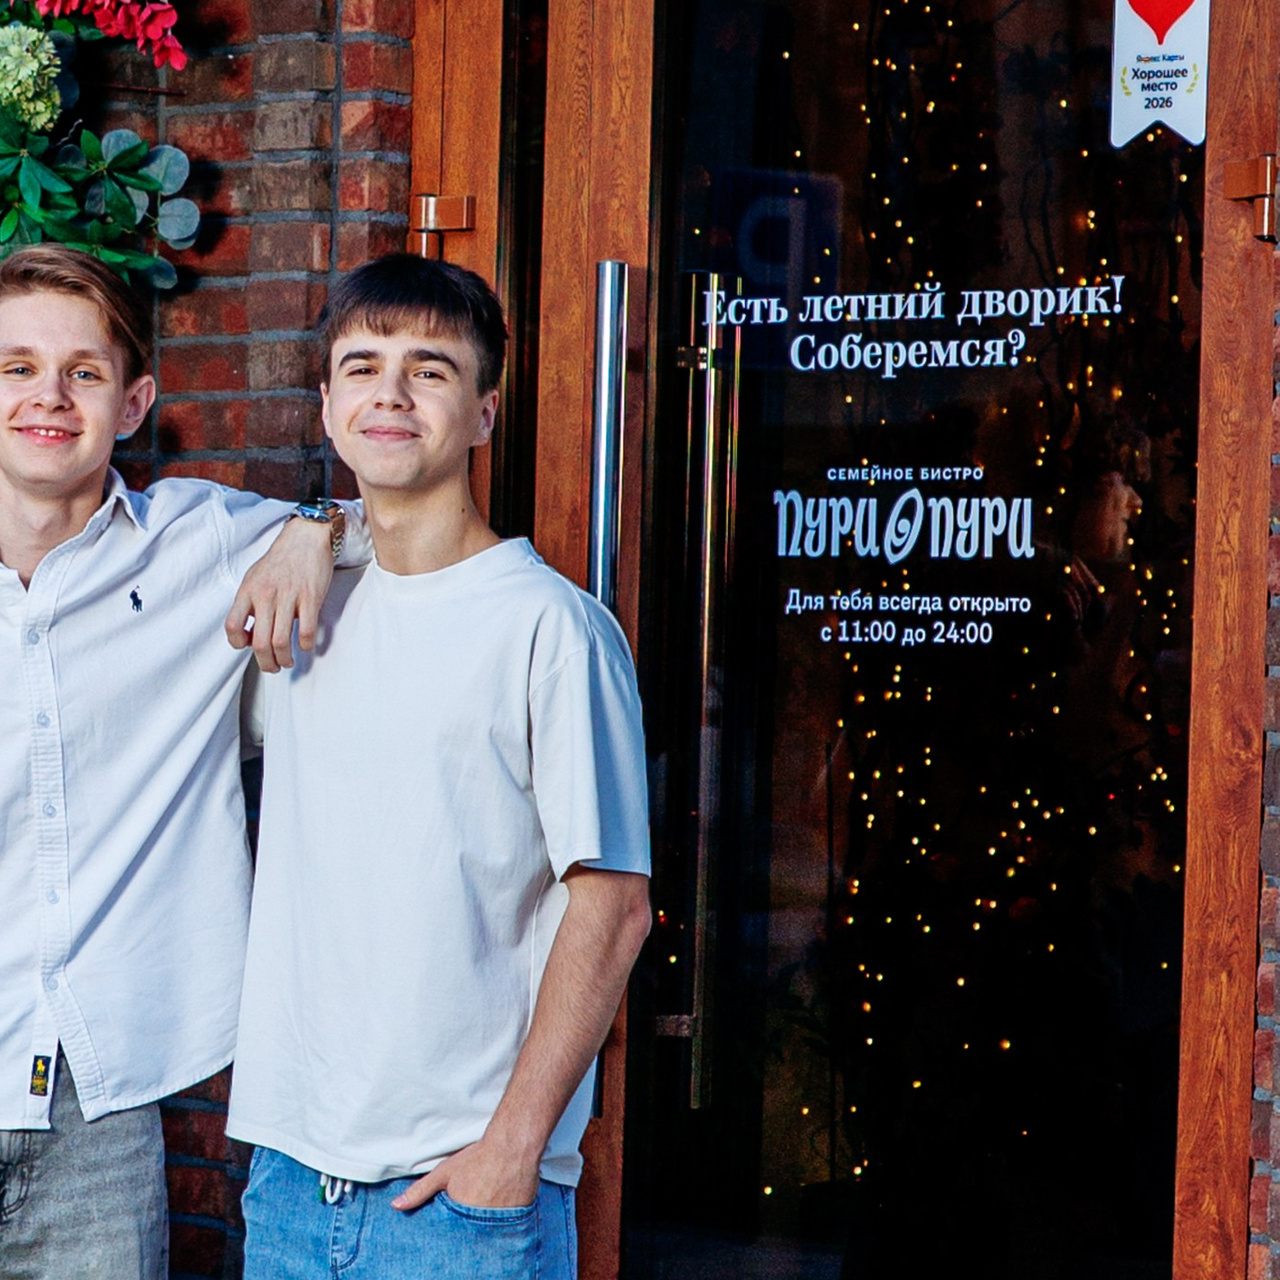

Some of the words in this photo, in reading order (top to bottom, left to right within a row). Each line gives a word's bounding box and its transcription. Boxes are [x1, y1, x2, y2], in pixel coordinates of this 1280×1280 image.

[1131, 68, 1188, 81] Хорошее
[1141, 81, 1178, 92] место
[1144, 96, 1173, 109] 2026
[701, 290, 789, 325] Есть
[798, 281, 946, 322] летний
[957, 275, 1126, 327] дворик!
[790, 328, 1026, 379] Соберемся?
[826, 464, 914, 481] СЕМЕЙНОЕ
[920, 467, 985, 481] БИСТРО
[785, 588, 824, 615] Для
[829, 588, 873, 611] тебя
[878, 595, 943, 616] всегда
[949, 596, 1032, 616] открыто
[821, 626, 832, 642] с
[838, 620, 897, 642] 11:00
[901, 627, 926, 646] до
[933, 622, 993, 643] 24:00
